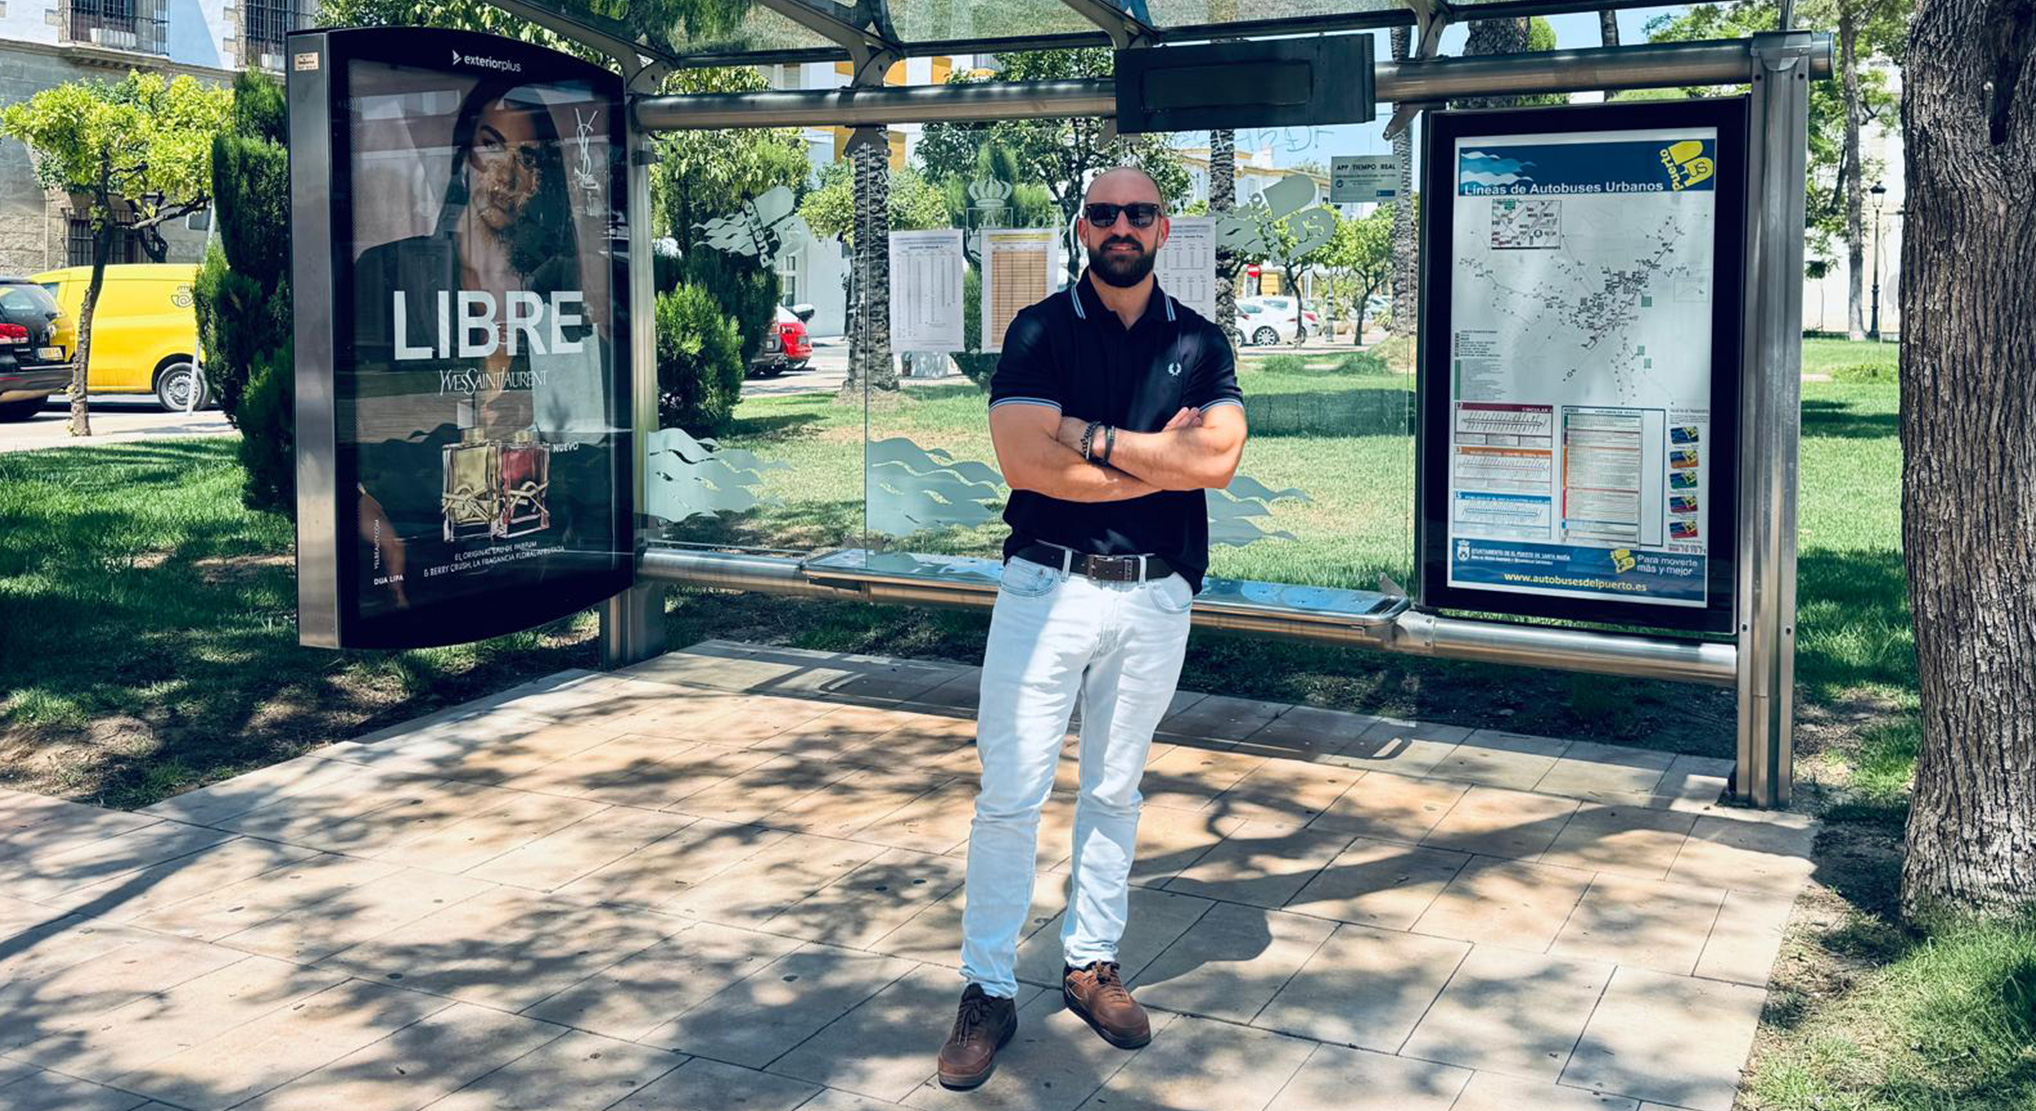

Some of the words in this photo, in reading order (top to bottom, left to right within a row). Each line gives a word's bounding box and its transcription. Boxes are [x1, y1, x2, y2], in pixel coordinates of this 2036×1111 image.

[463, 55, 522, 73] exteriorplus
[1510, 183, 1527, 194] de
[1529, 182, 1602, 195] Autobuses
[1605, 181, 1664, 192] Urbanos
[393, 290, 584, 361] LIBRE
[552, 441, 580, 454] NUEVO
[1637, 554, 1659, 565] Para
[1661, 557, 1699, 567] moverte
[1658, 566, 1665, 576] y
[1666, 566, 1693, 577] mejor
[373, 577, 388, 586] DUA
[389, 574, 405, 583] LIPA
[1503, 572, 1648, 592] www.autobusesdelpuerto.es
